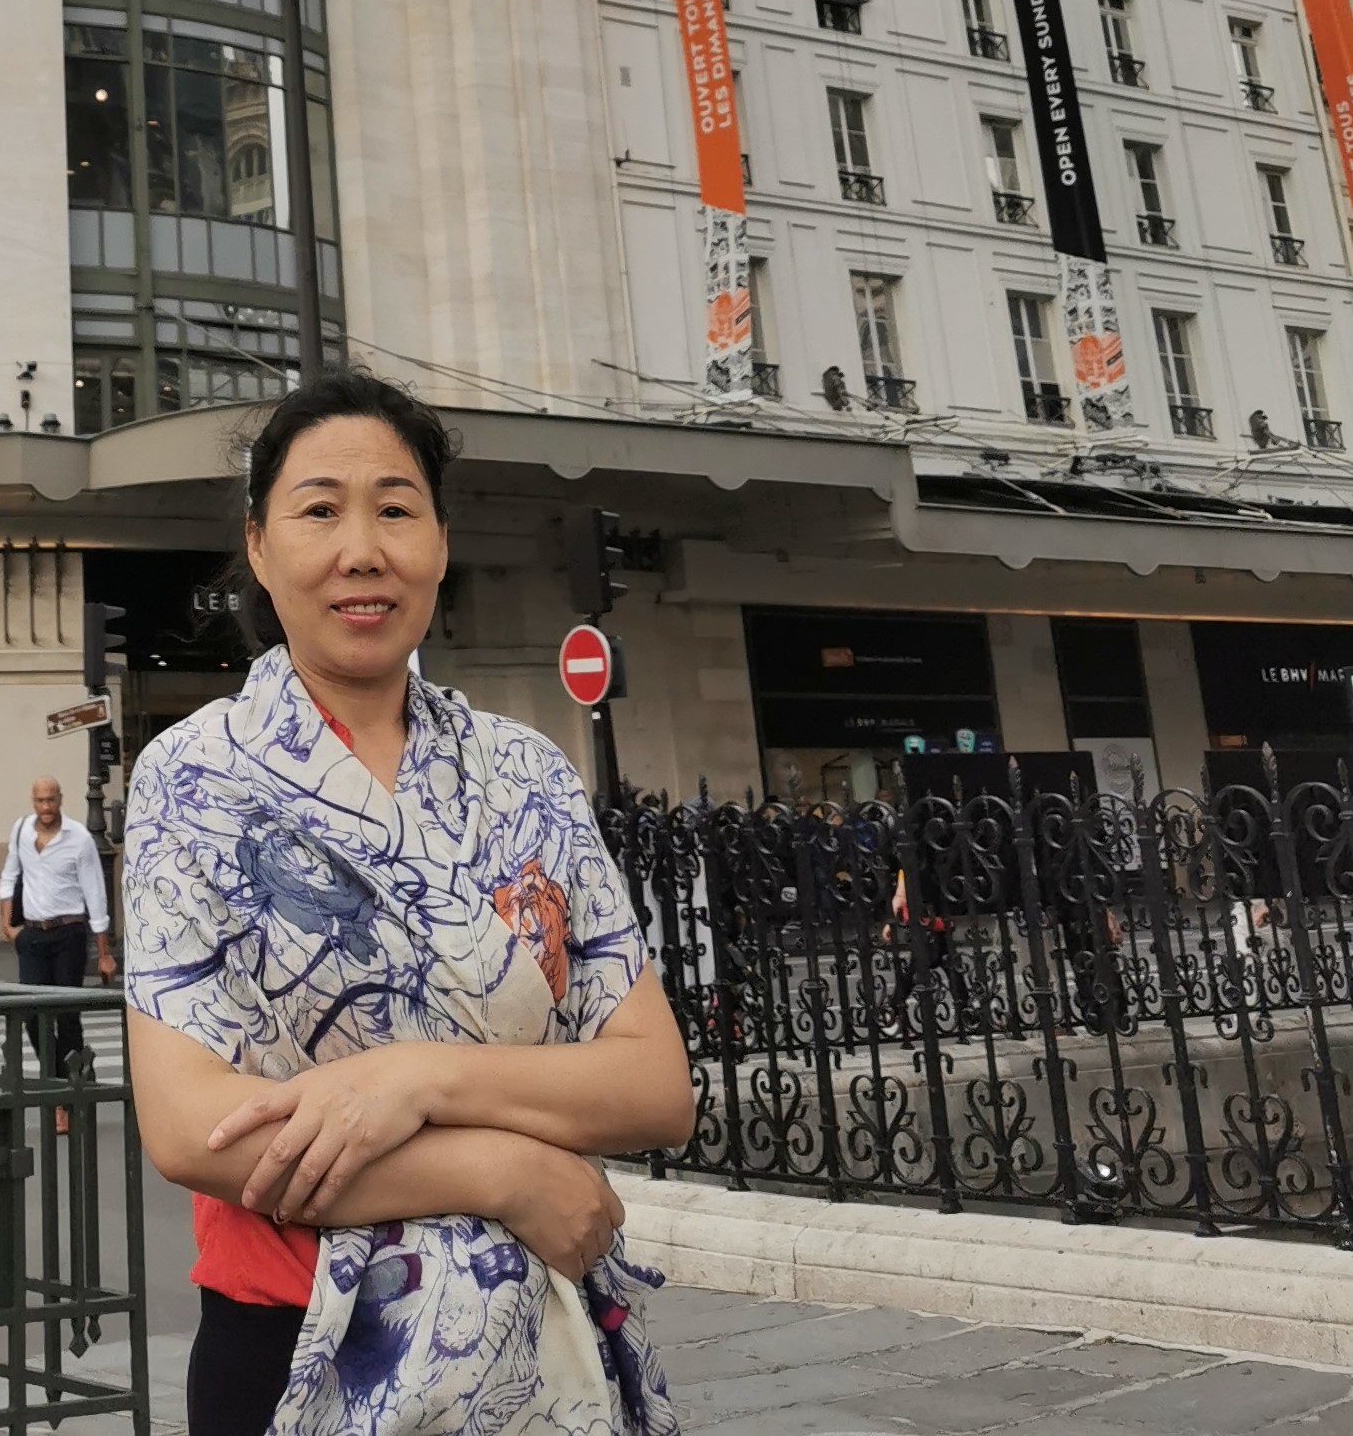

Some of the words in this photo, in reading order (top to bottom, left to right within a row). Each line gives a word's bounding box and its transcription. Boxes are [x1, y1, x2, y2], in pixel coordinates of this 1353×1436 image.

[690, 41, 715, 134] OUVERT
[714, 84, 732, 130] LES
[1039, 54, 1066, 122] EVERY
[1053, 125, 1077, 187] OPEN
[193, 592, 219, 610] LE
[1261, 667, 1280, 683] LE
